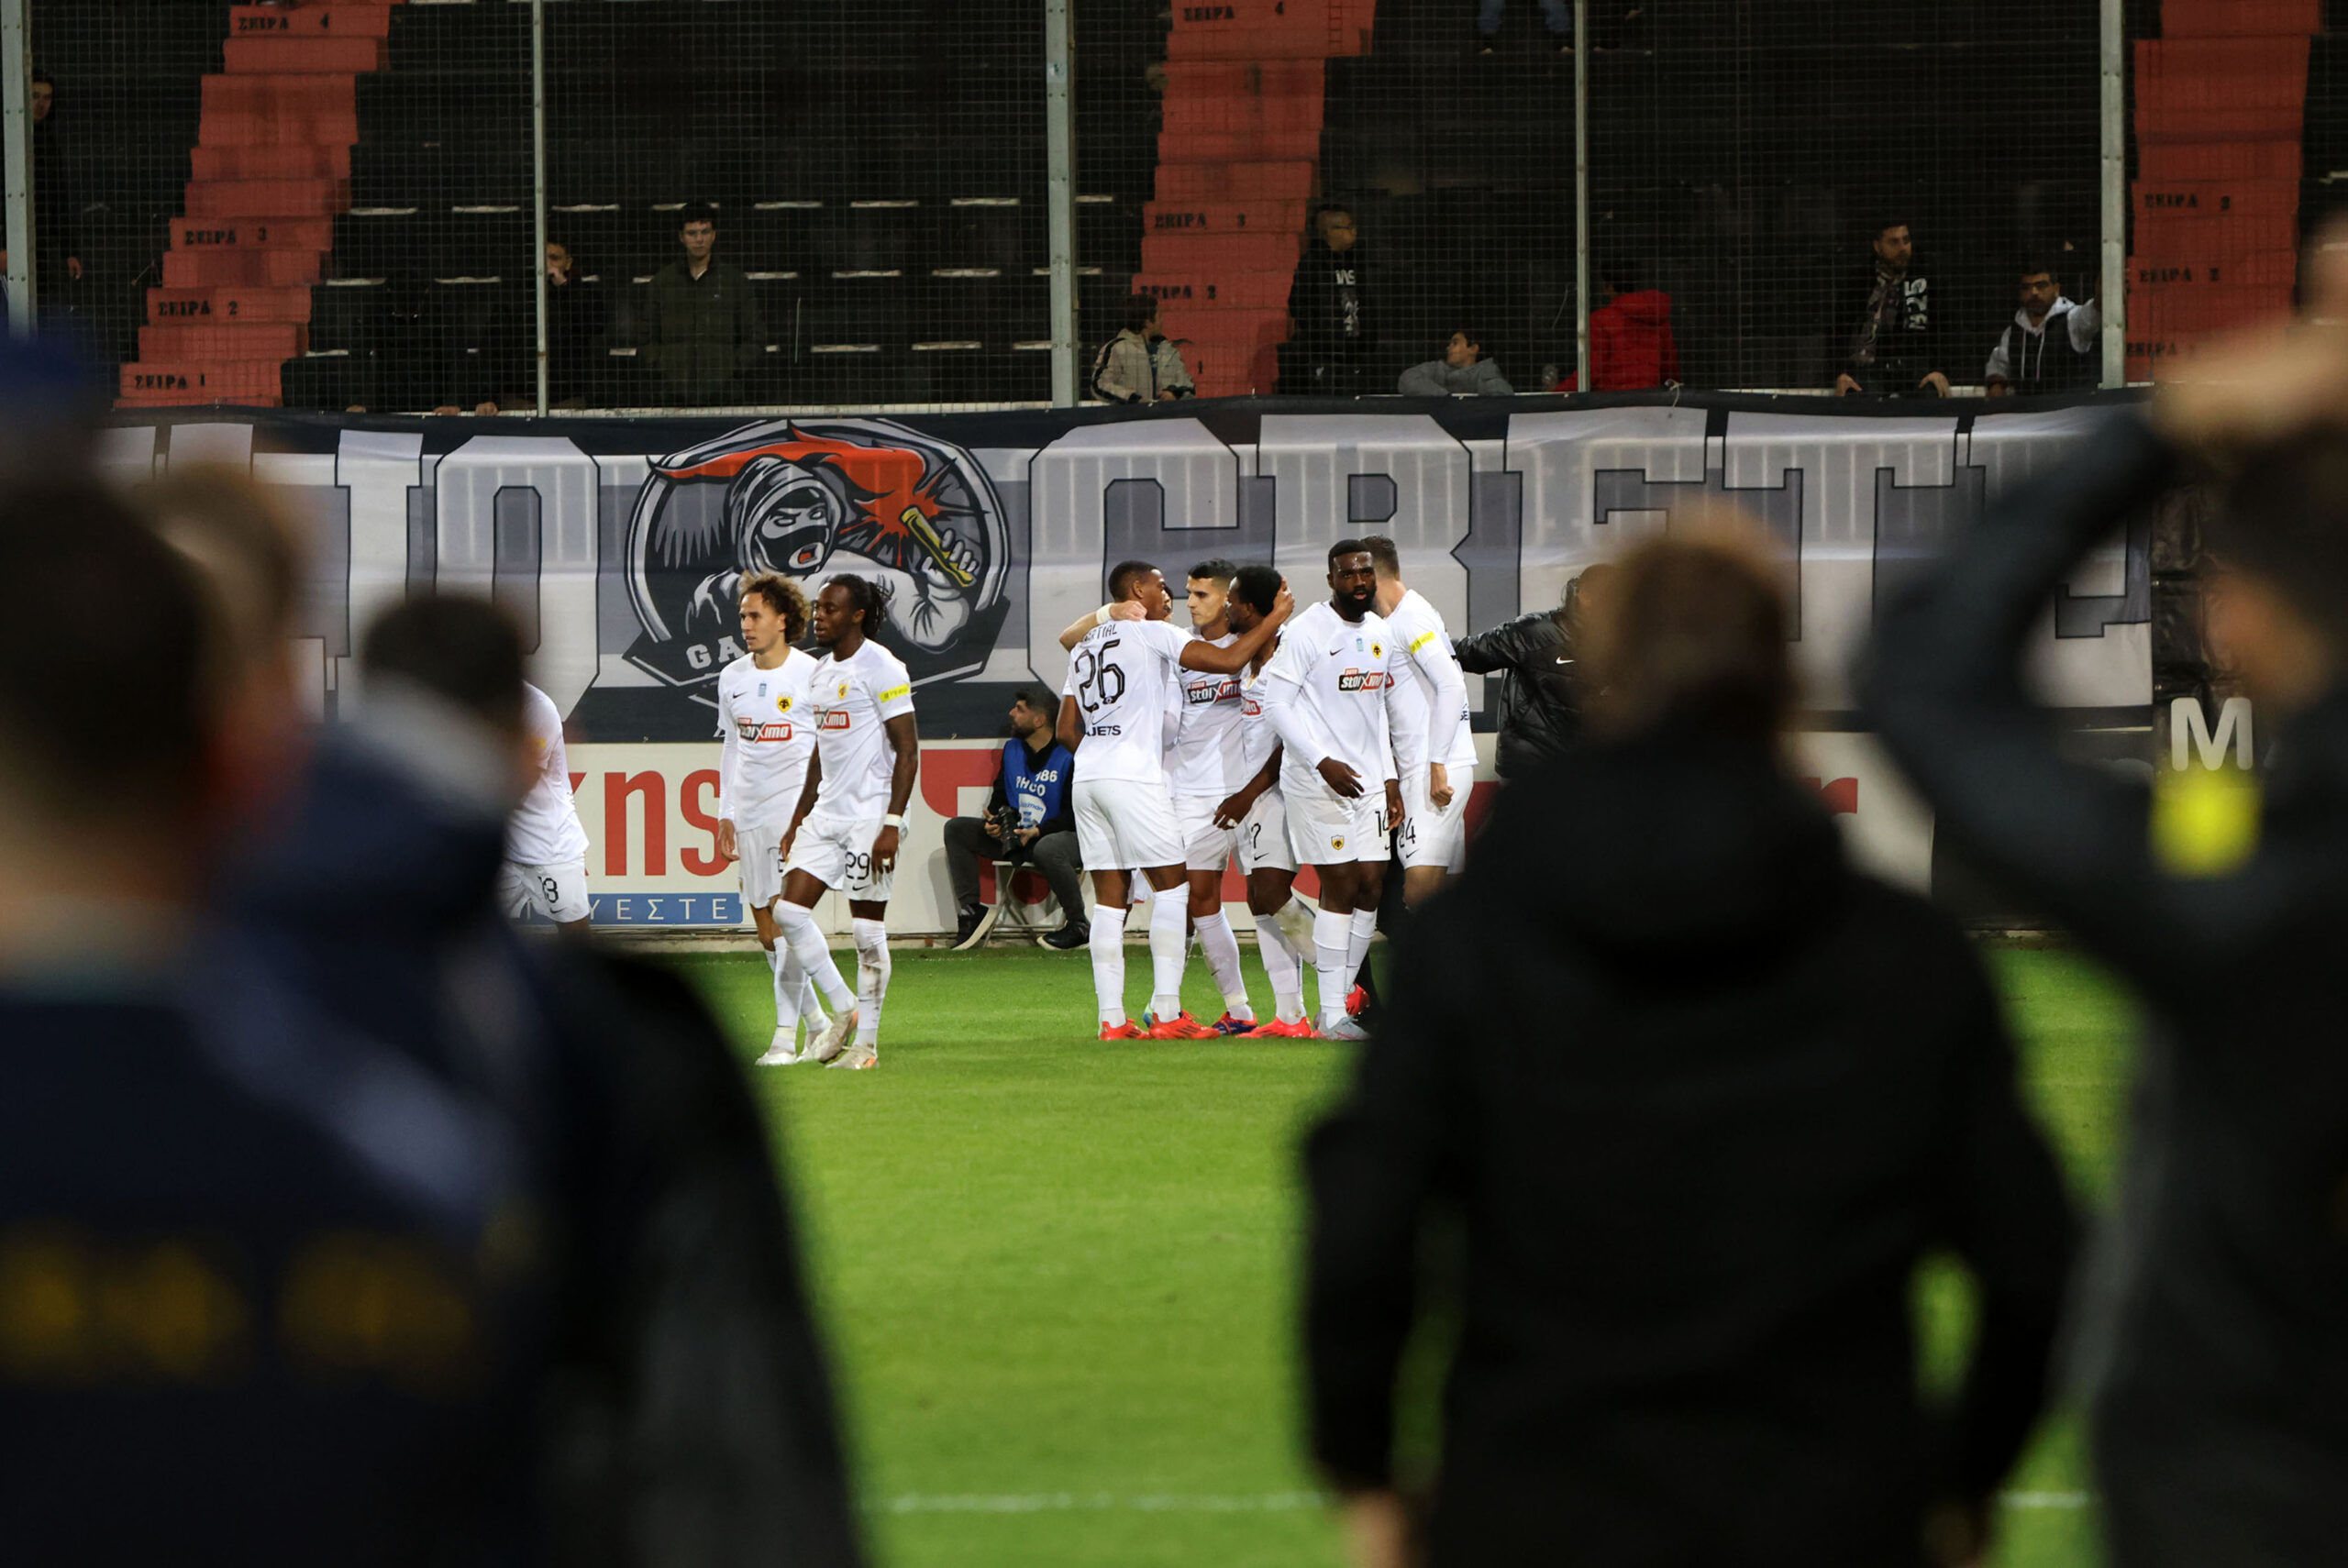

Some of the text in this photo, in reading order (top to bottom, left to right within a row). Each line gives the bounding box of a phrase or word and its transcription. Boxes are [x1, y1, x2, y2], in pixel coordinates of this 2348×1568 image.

[229, 301, 238, 315] 2
[685, 635, 745, 669] GA
[1074, 638, 1126, 713] 26
[2170, 697, 2254, 771] M
[844, 851, 869, 880] 29
[526, 898, 727, 921] ΥΕΣΤΕ
